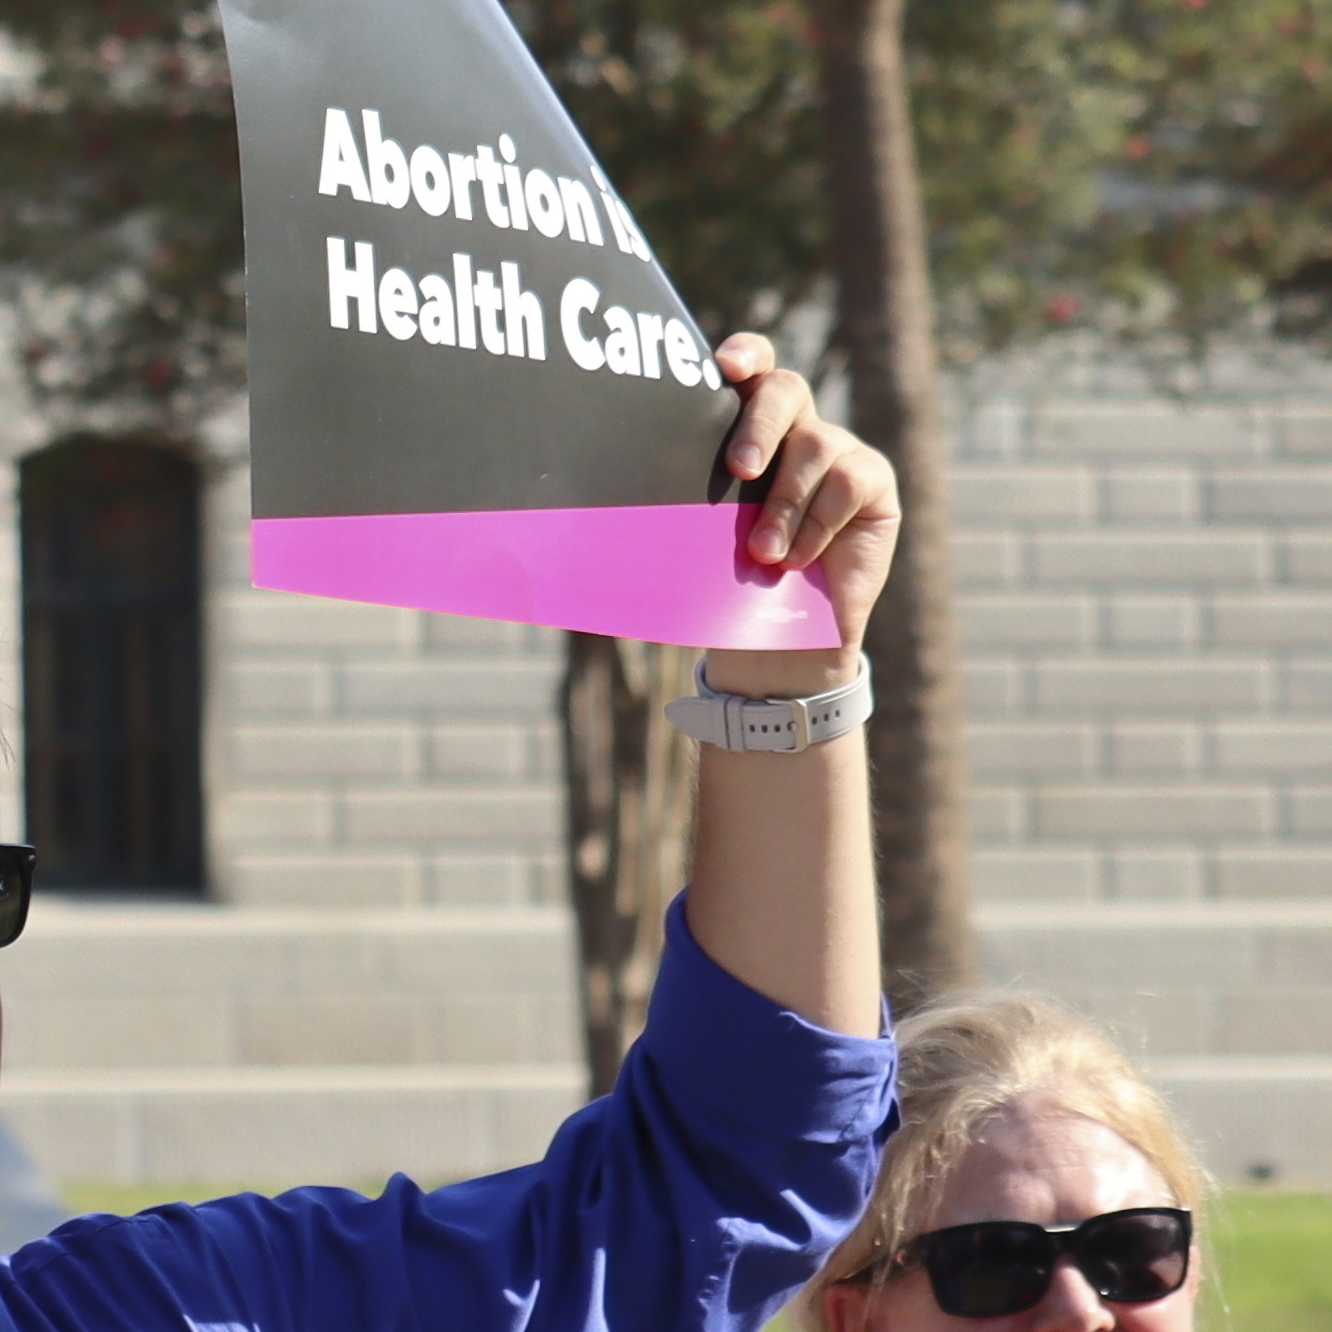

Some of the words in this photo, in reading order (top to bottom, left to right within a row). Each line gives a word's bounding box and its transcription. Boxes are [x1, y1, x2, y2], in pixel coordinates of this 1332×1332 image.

[318, 108, 604, 247] Abortion
[326, 236, 547, 361] Health
[560, 276, 722, 391] Care.
